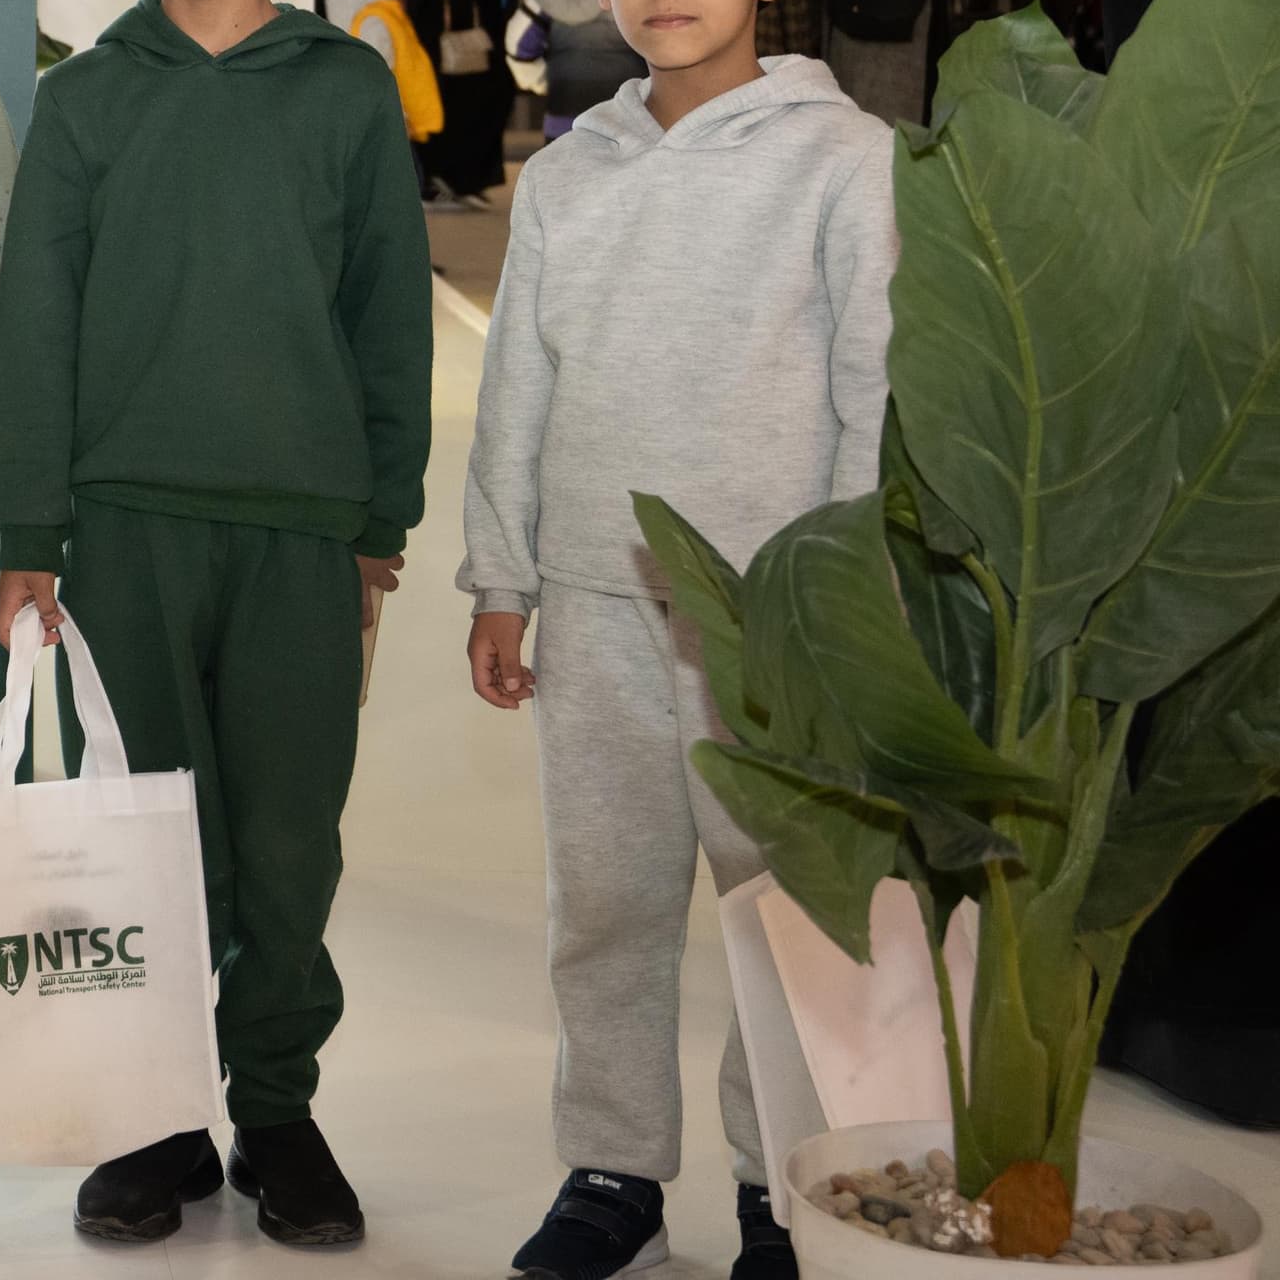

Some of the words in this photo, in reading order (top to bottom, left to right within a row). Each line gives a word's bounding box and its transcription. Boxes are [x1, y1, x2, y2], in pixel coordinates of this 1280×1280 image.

[34, 926, 145, 972] NTSC
[58, 975, 86, 985] لسلامة
[87, 971, 119, 982] الوطني
[121, 969, 146, 980] المركز
[38, 976, 56, 988] النقل
[38, 987, 66, 997] National
[66, 985, 97, 994] Transport
[98, 981, 121, 992] Safety
[122, 980, 146, 989] Center
